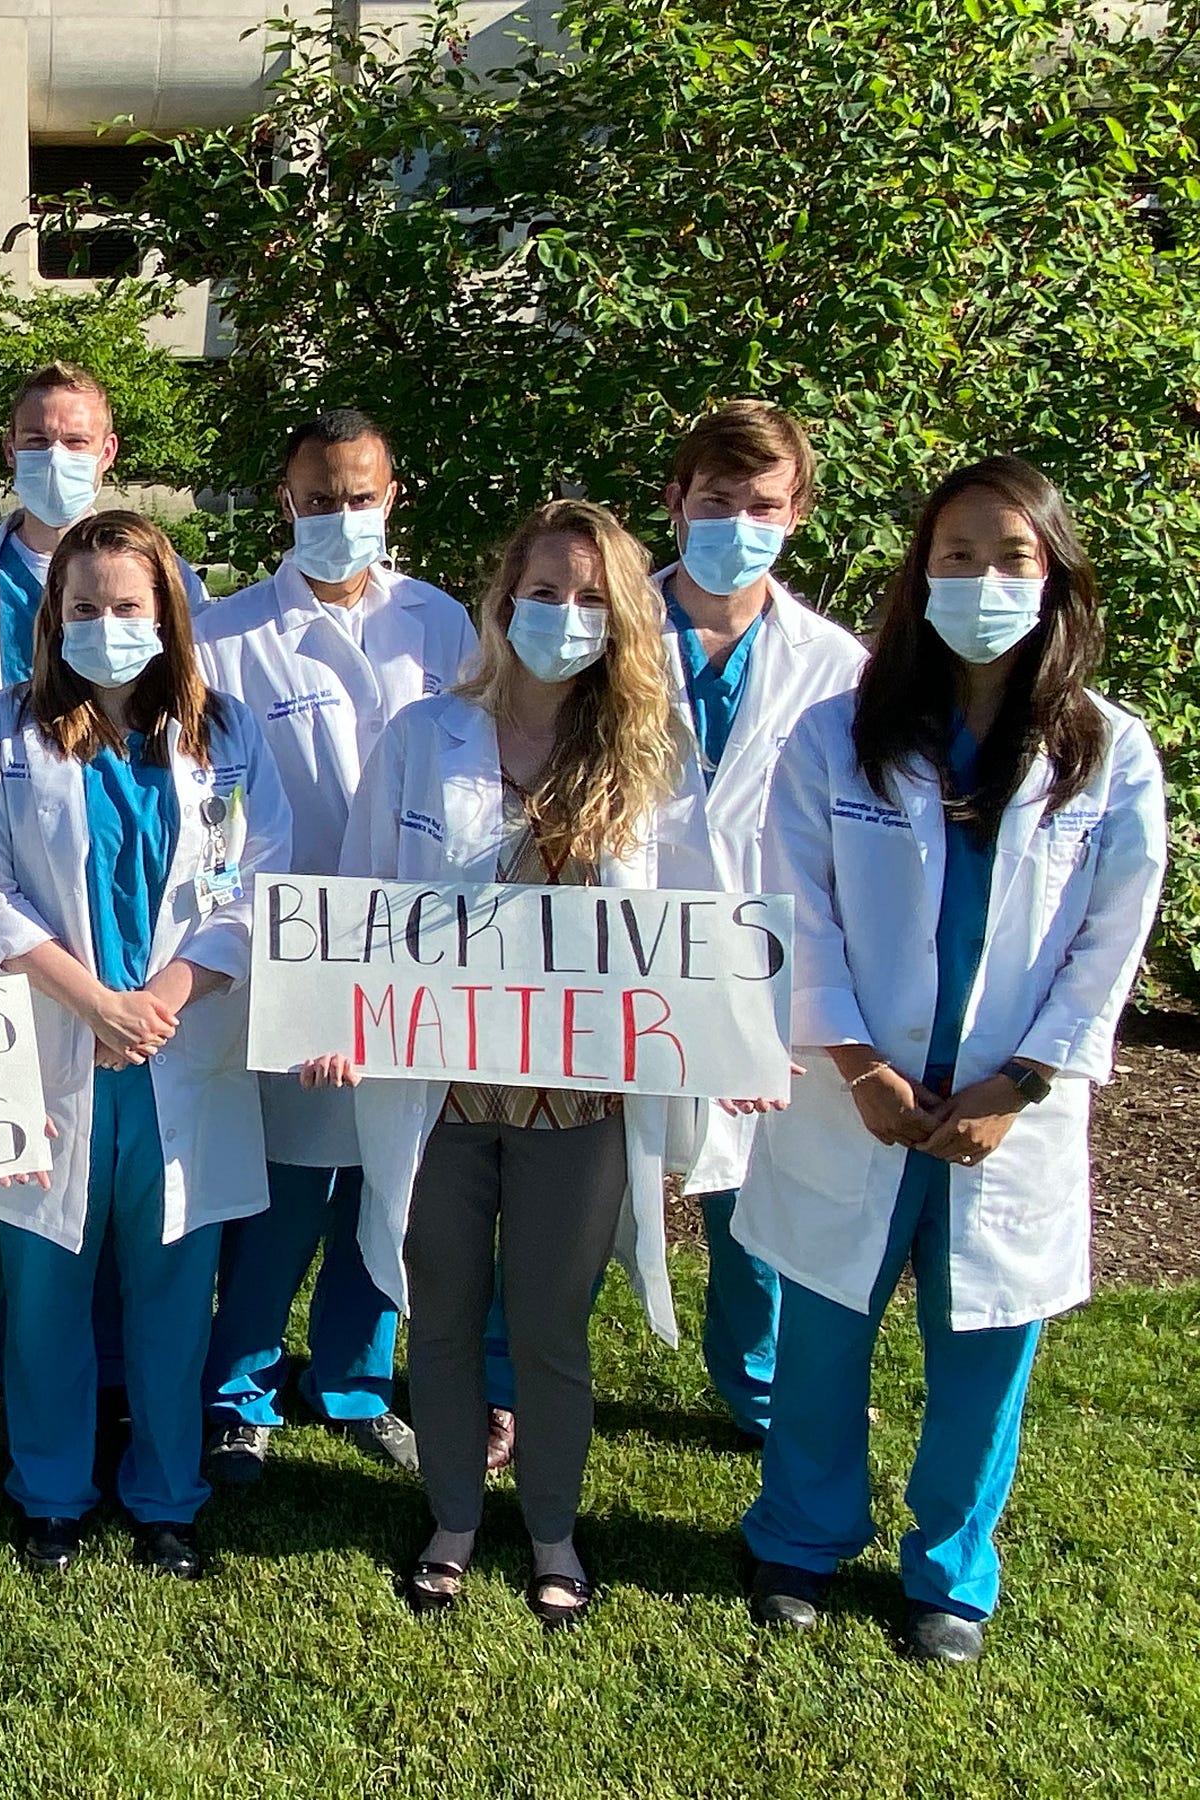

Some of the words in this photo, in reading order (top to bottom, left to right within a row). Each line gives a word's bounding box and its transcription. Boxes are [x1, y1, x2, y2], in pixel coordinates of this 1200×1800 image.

[268, 883, 505, 970] BLACK
[541, 894, 784, 982] LIVES
[353, 982, 686, 1088] MATTER
